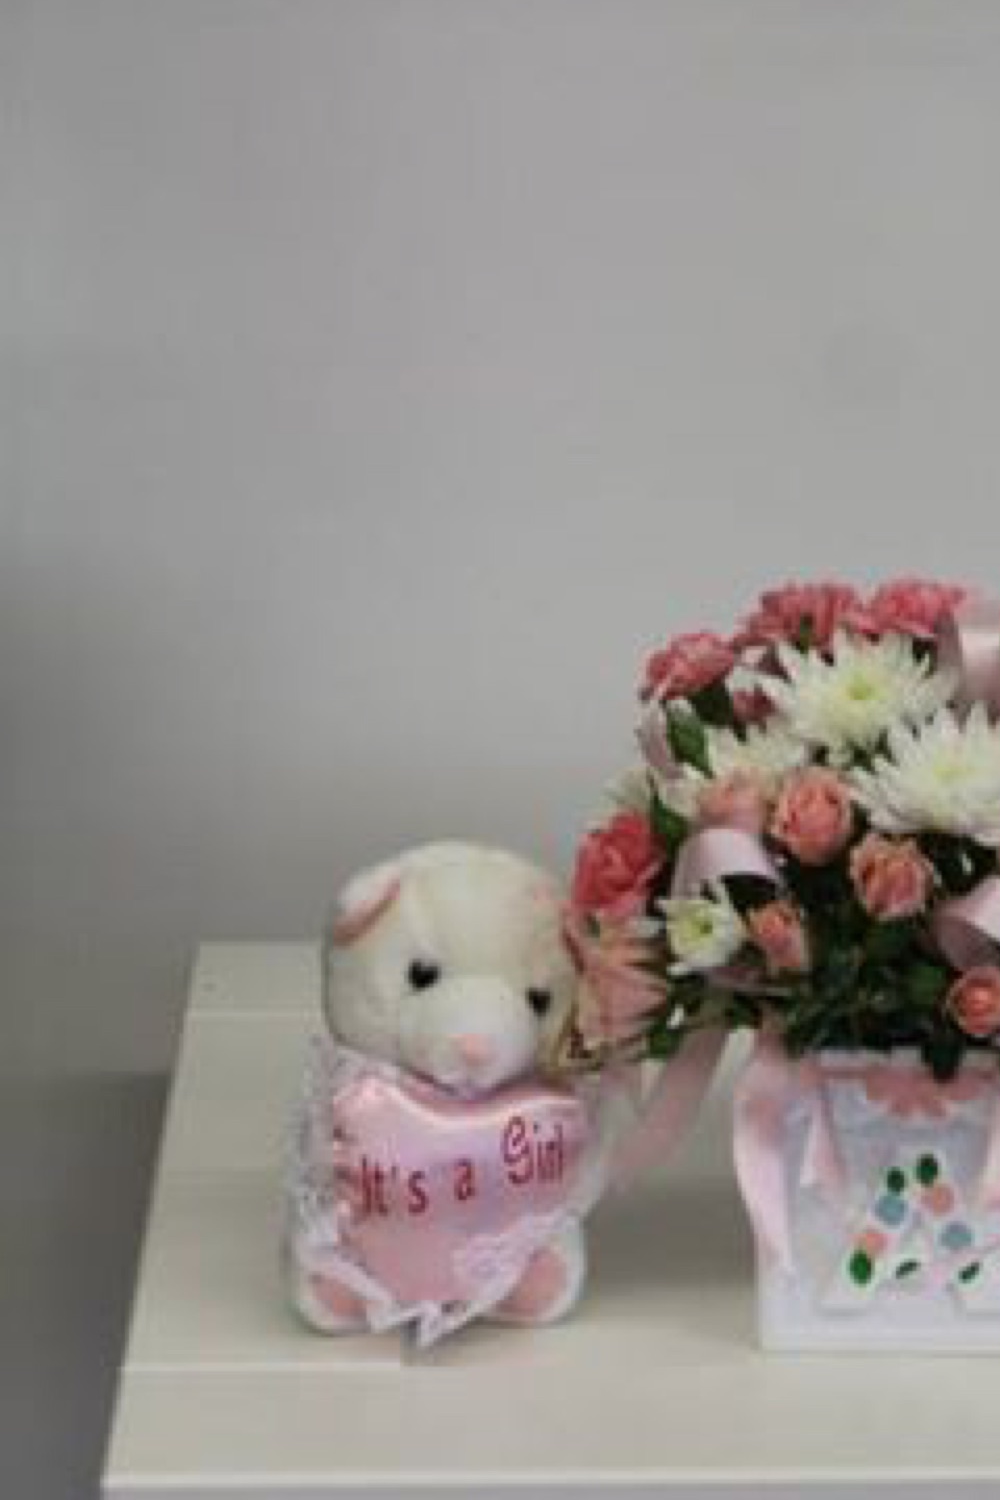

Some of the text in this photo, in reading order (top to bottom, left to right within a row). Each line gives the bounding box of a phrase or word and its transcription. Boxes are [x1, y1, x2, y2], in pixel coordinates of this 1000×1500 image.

[360, 1115, 564, 1216] It's a Girl
